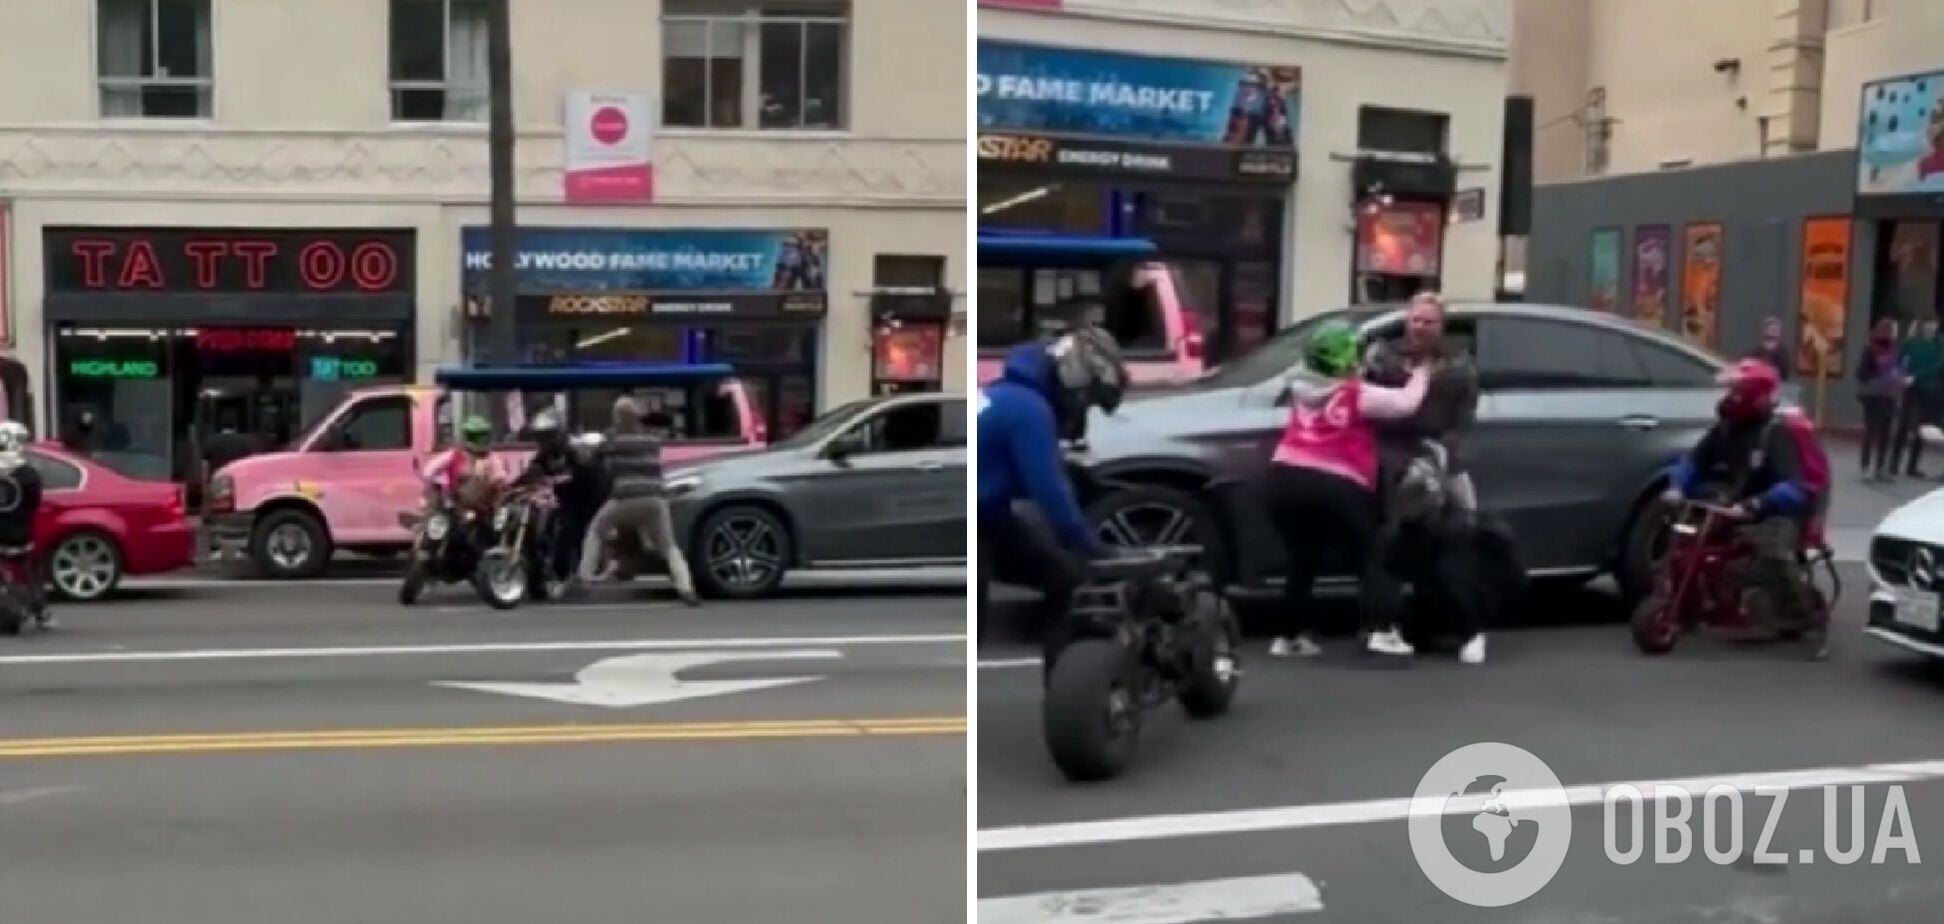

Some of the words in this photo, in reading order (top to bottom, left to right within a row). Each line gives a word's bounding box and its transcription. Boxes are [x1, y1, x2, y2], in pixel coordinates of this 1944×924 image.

[999, 75, 1081, 102] FAME
[1090, 81, 1213, 113] MARKET
[465, 252, 605, 270] HOYWOOD
[610, 252, 668, 270] FAME
[673, 253, 763, 271] MARKET
[549, 295, 648, 313] ROCKSTAR
